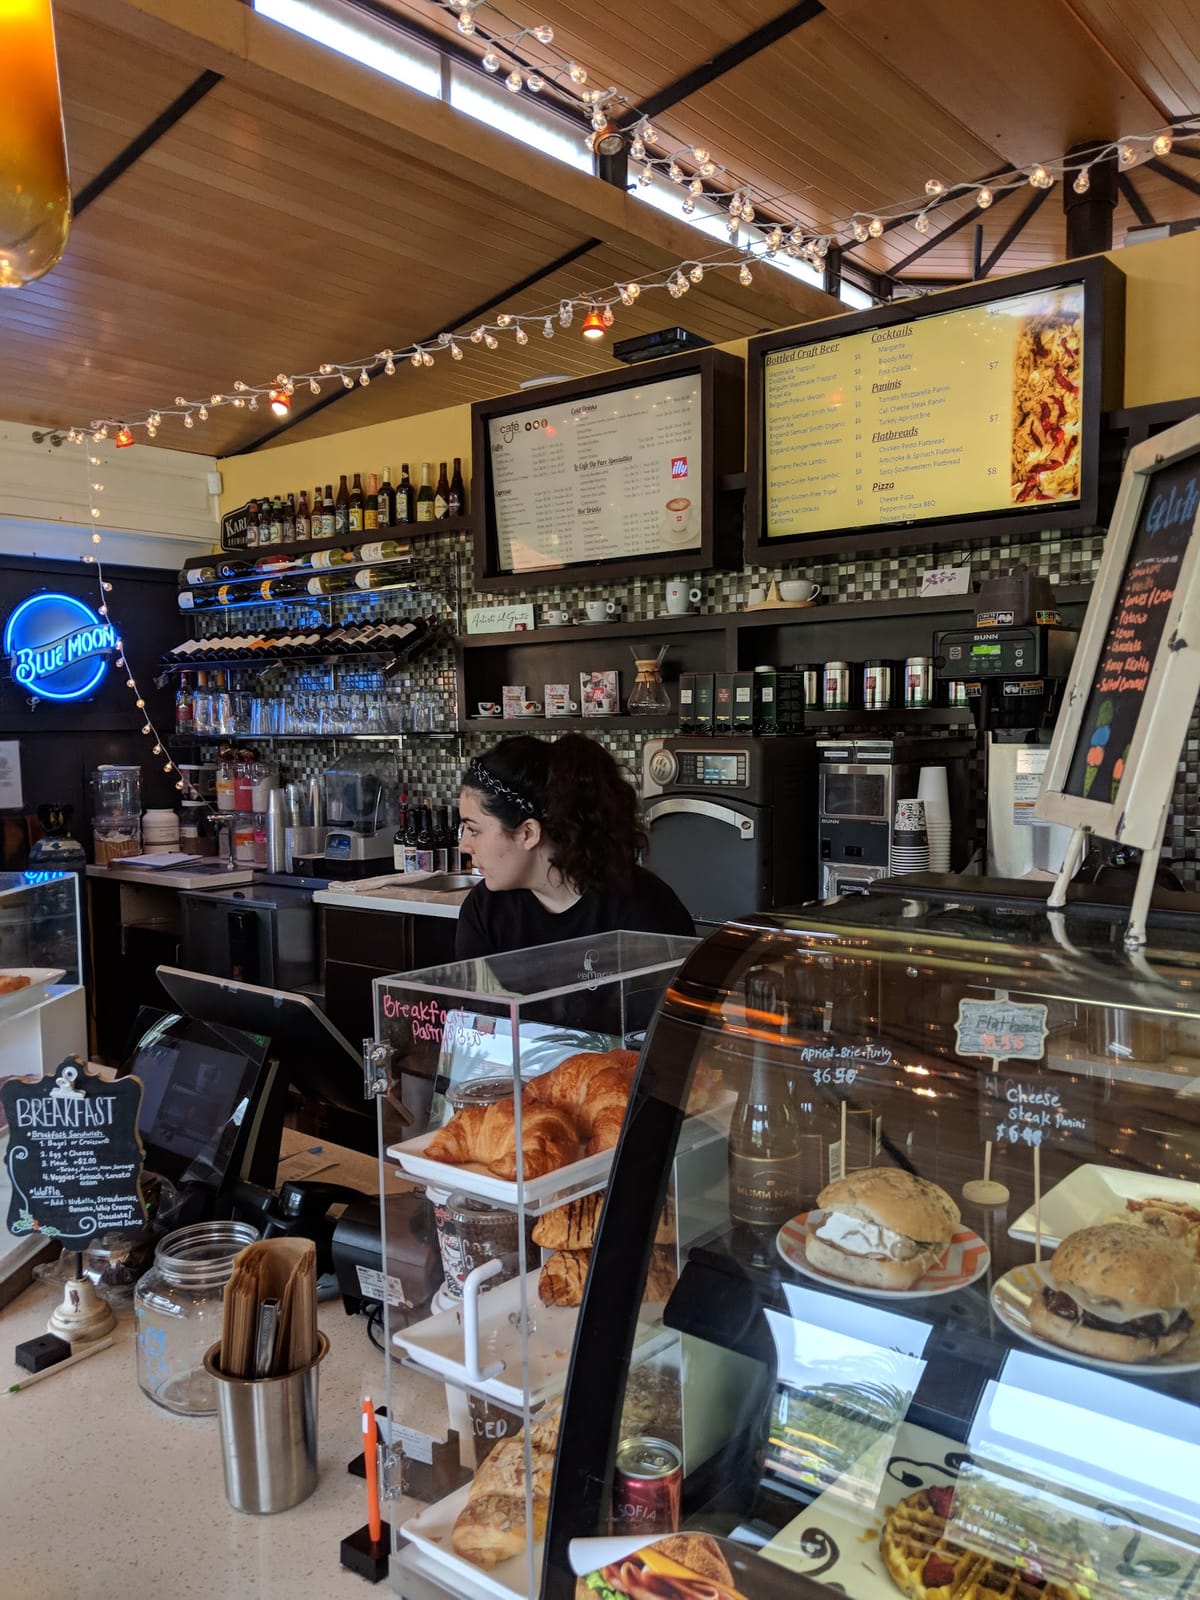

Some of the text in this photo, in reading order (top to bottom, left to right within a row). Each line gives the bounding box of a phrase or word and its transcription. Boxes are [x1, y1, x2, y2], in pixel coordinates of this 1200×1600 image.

[871, 325, 913, 343] Cocktails
[767, 344, 840, 366] Bottled Craft Beer
[872, 379, 902, 393] Paninis
[872, 426, 919, 443] Flatbreads
[672, 461, 687, 476] illy
[872, 482, 895, 492] Pizza
[68, 625, 115, 661] MOON
[383, 994, 470, 1025] Breakfast
[1007, 1084, 1061, 1107] Cheese
[16, 1097, 117, 1127] BREAKFAST
[1056, 1113, 1086, 1128] Panini
[618, 1504, 656, 1521] SOFIA
